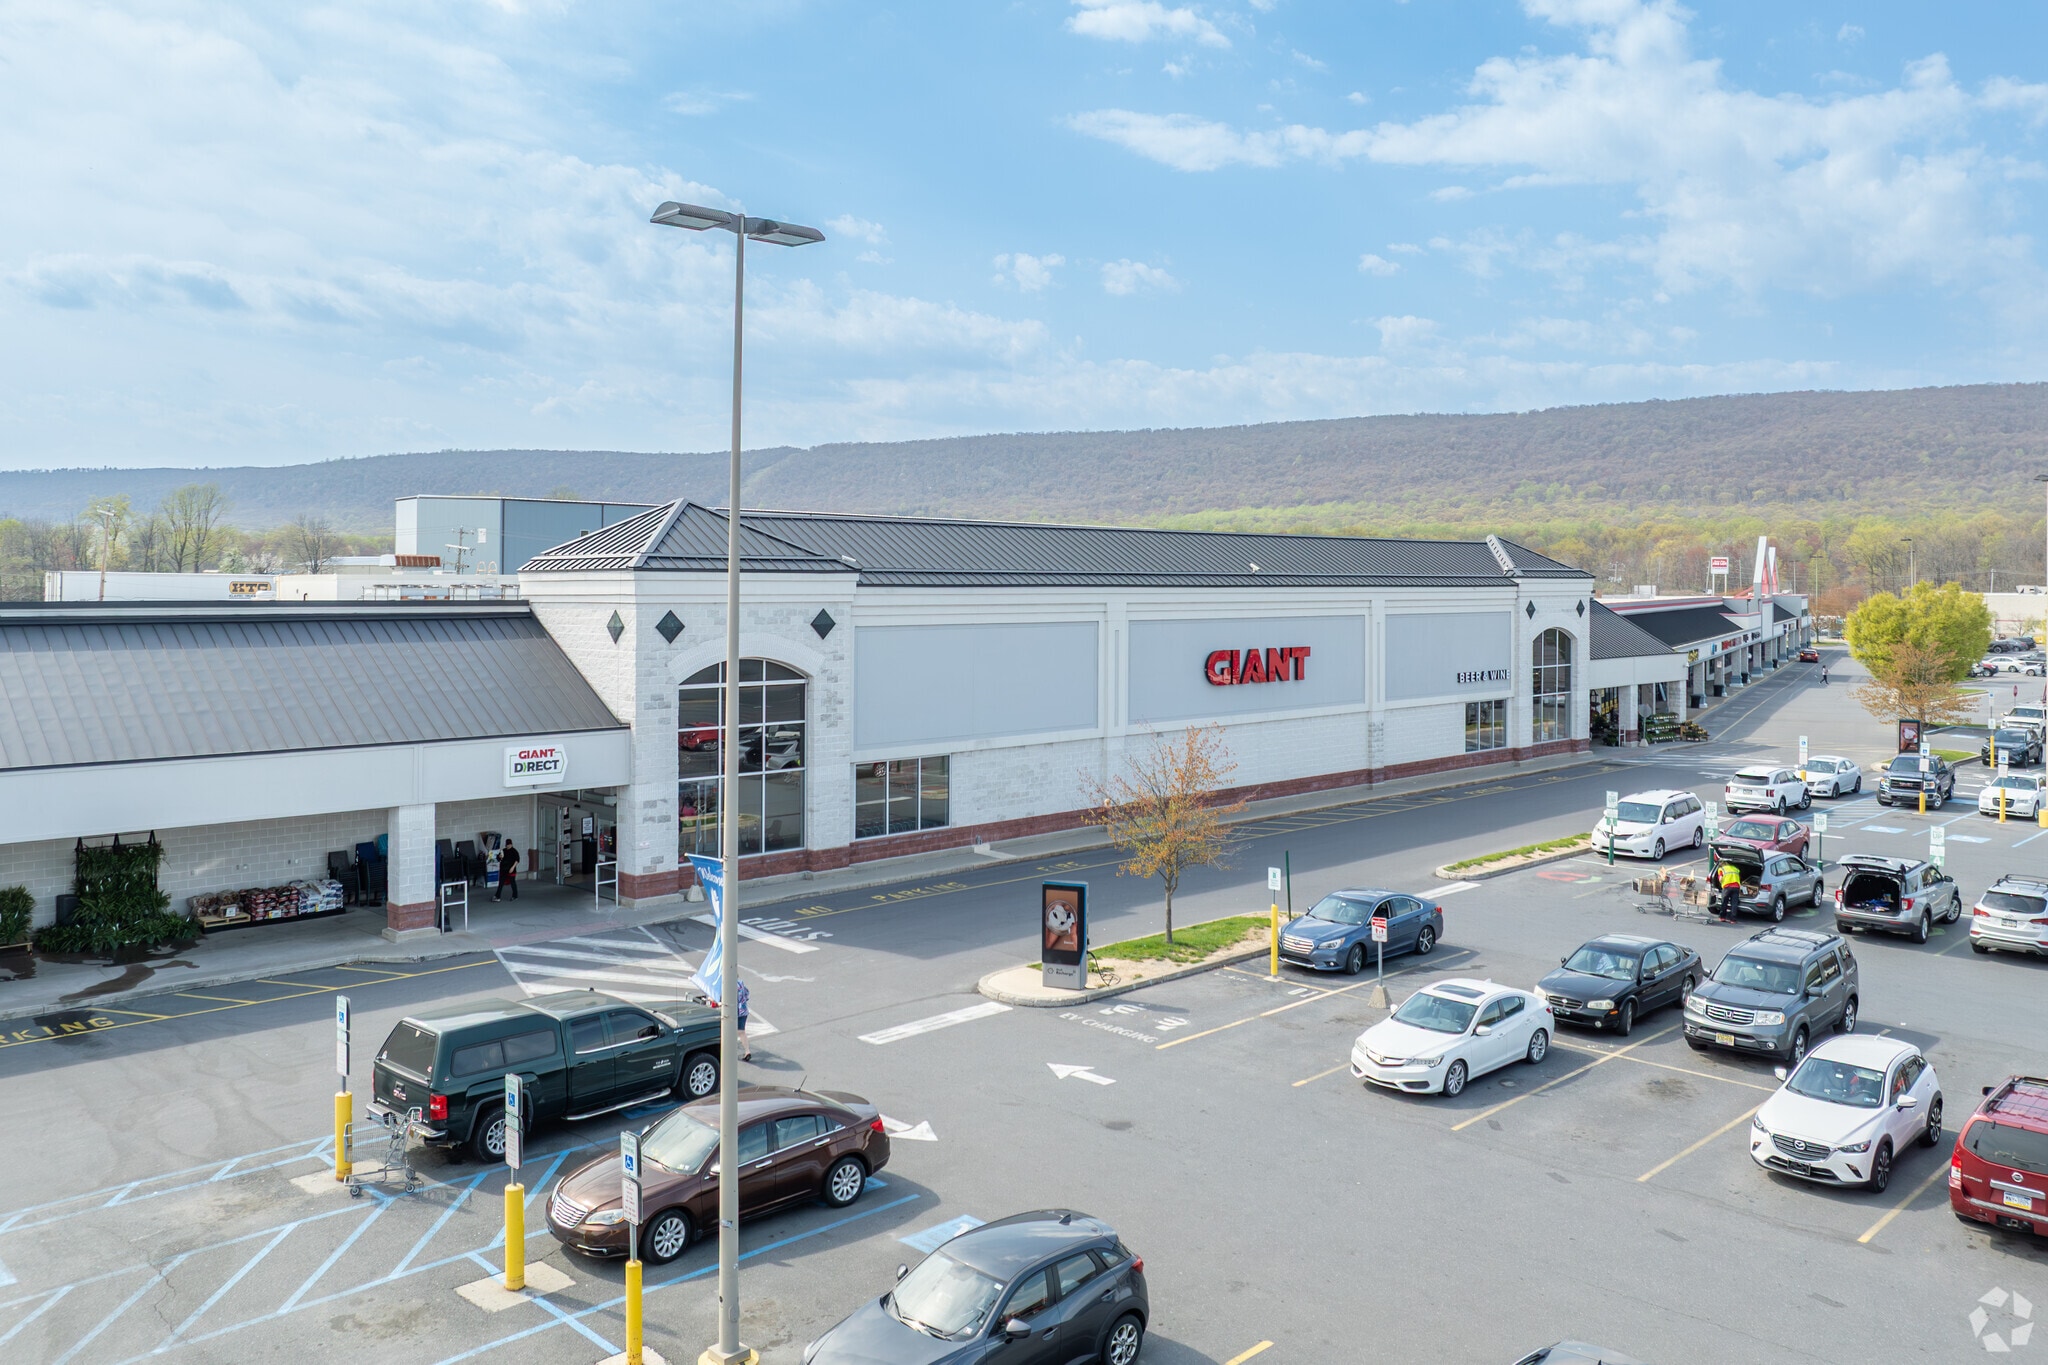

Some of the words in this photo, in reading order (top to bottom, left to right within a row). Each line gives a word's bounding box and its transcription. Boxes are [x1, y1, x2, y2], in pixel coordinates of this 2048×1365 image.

[1204, 646, 1311, 686] GIANT
[1457, 671, 1480, 683] BEER
[1481, 670, 1488, 681] &
[1488, 669, 1511, 680] WINE
[518, 748, 556, 760] GIANT
[514, 759, 560, 773] DIRECT
[1707, 829, 1715, 838] 2
[794, 906, 833, 916] NO
[871, 881, 968, 902] PARKING
[1036, 861, 1088, 872] FIRE
[739, 917, 834, 941] STOP
[1059, 1012, 1082, 1021] EV
[1082, 1018, 1159, 1044] CHARGING
